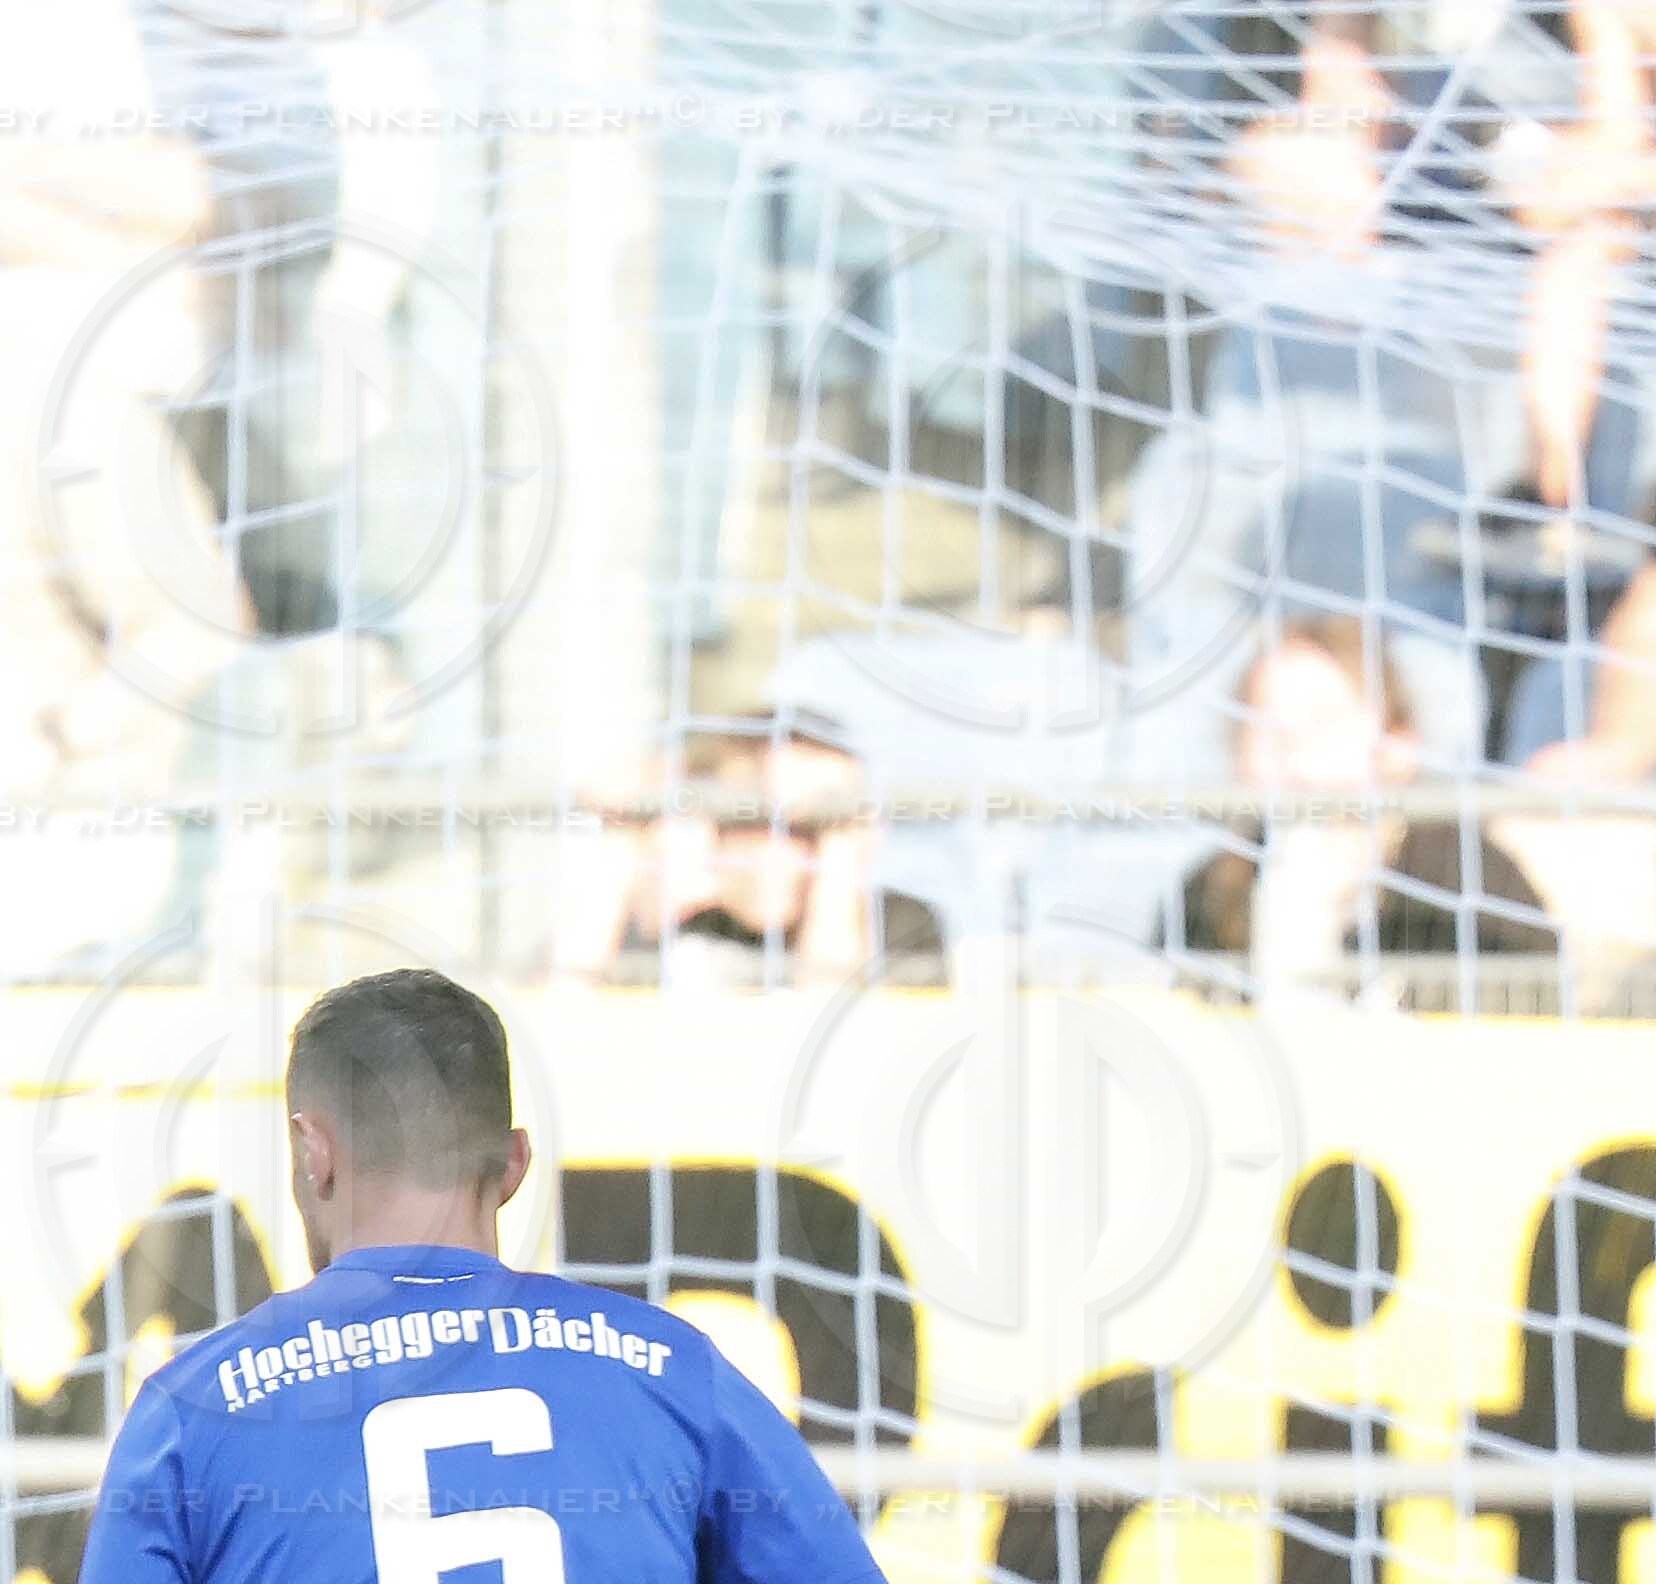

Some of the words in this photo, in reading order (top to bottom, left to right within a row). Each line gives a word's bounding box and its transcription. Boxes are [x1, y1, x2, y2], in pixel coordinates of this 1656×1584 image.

[217, 1308, 485, 1401] Hochegger
[488, 1307, 672, 1377] Dächer
[227, 1355, 373, 1412] HARTBERG
